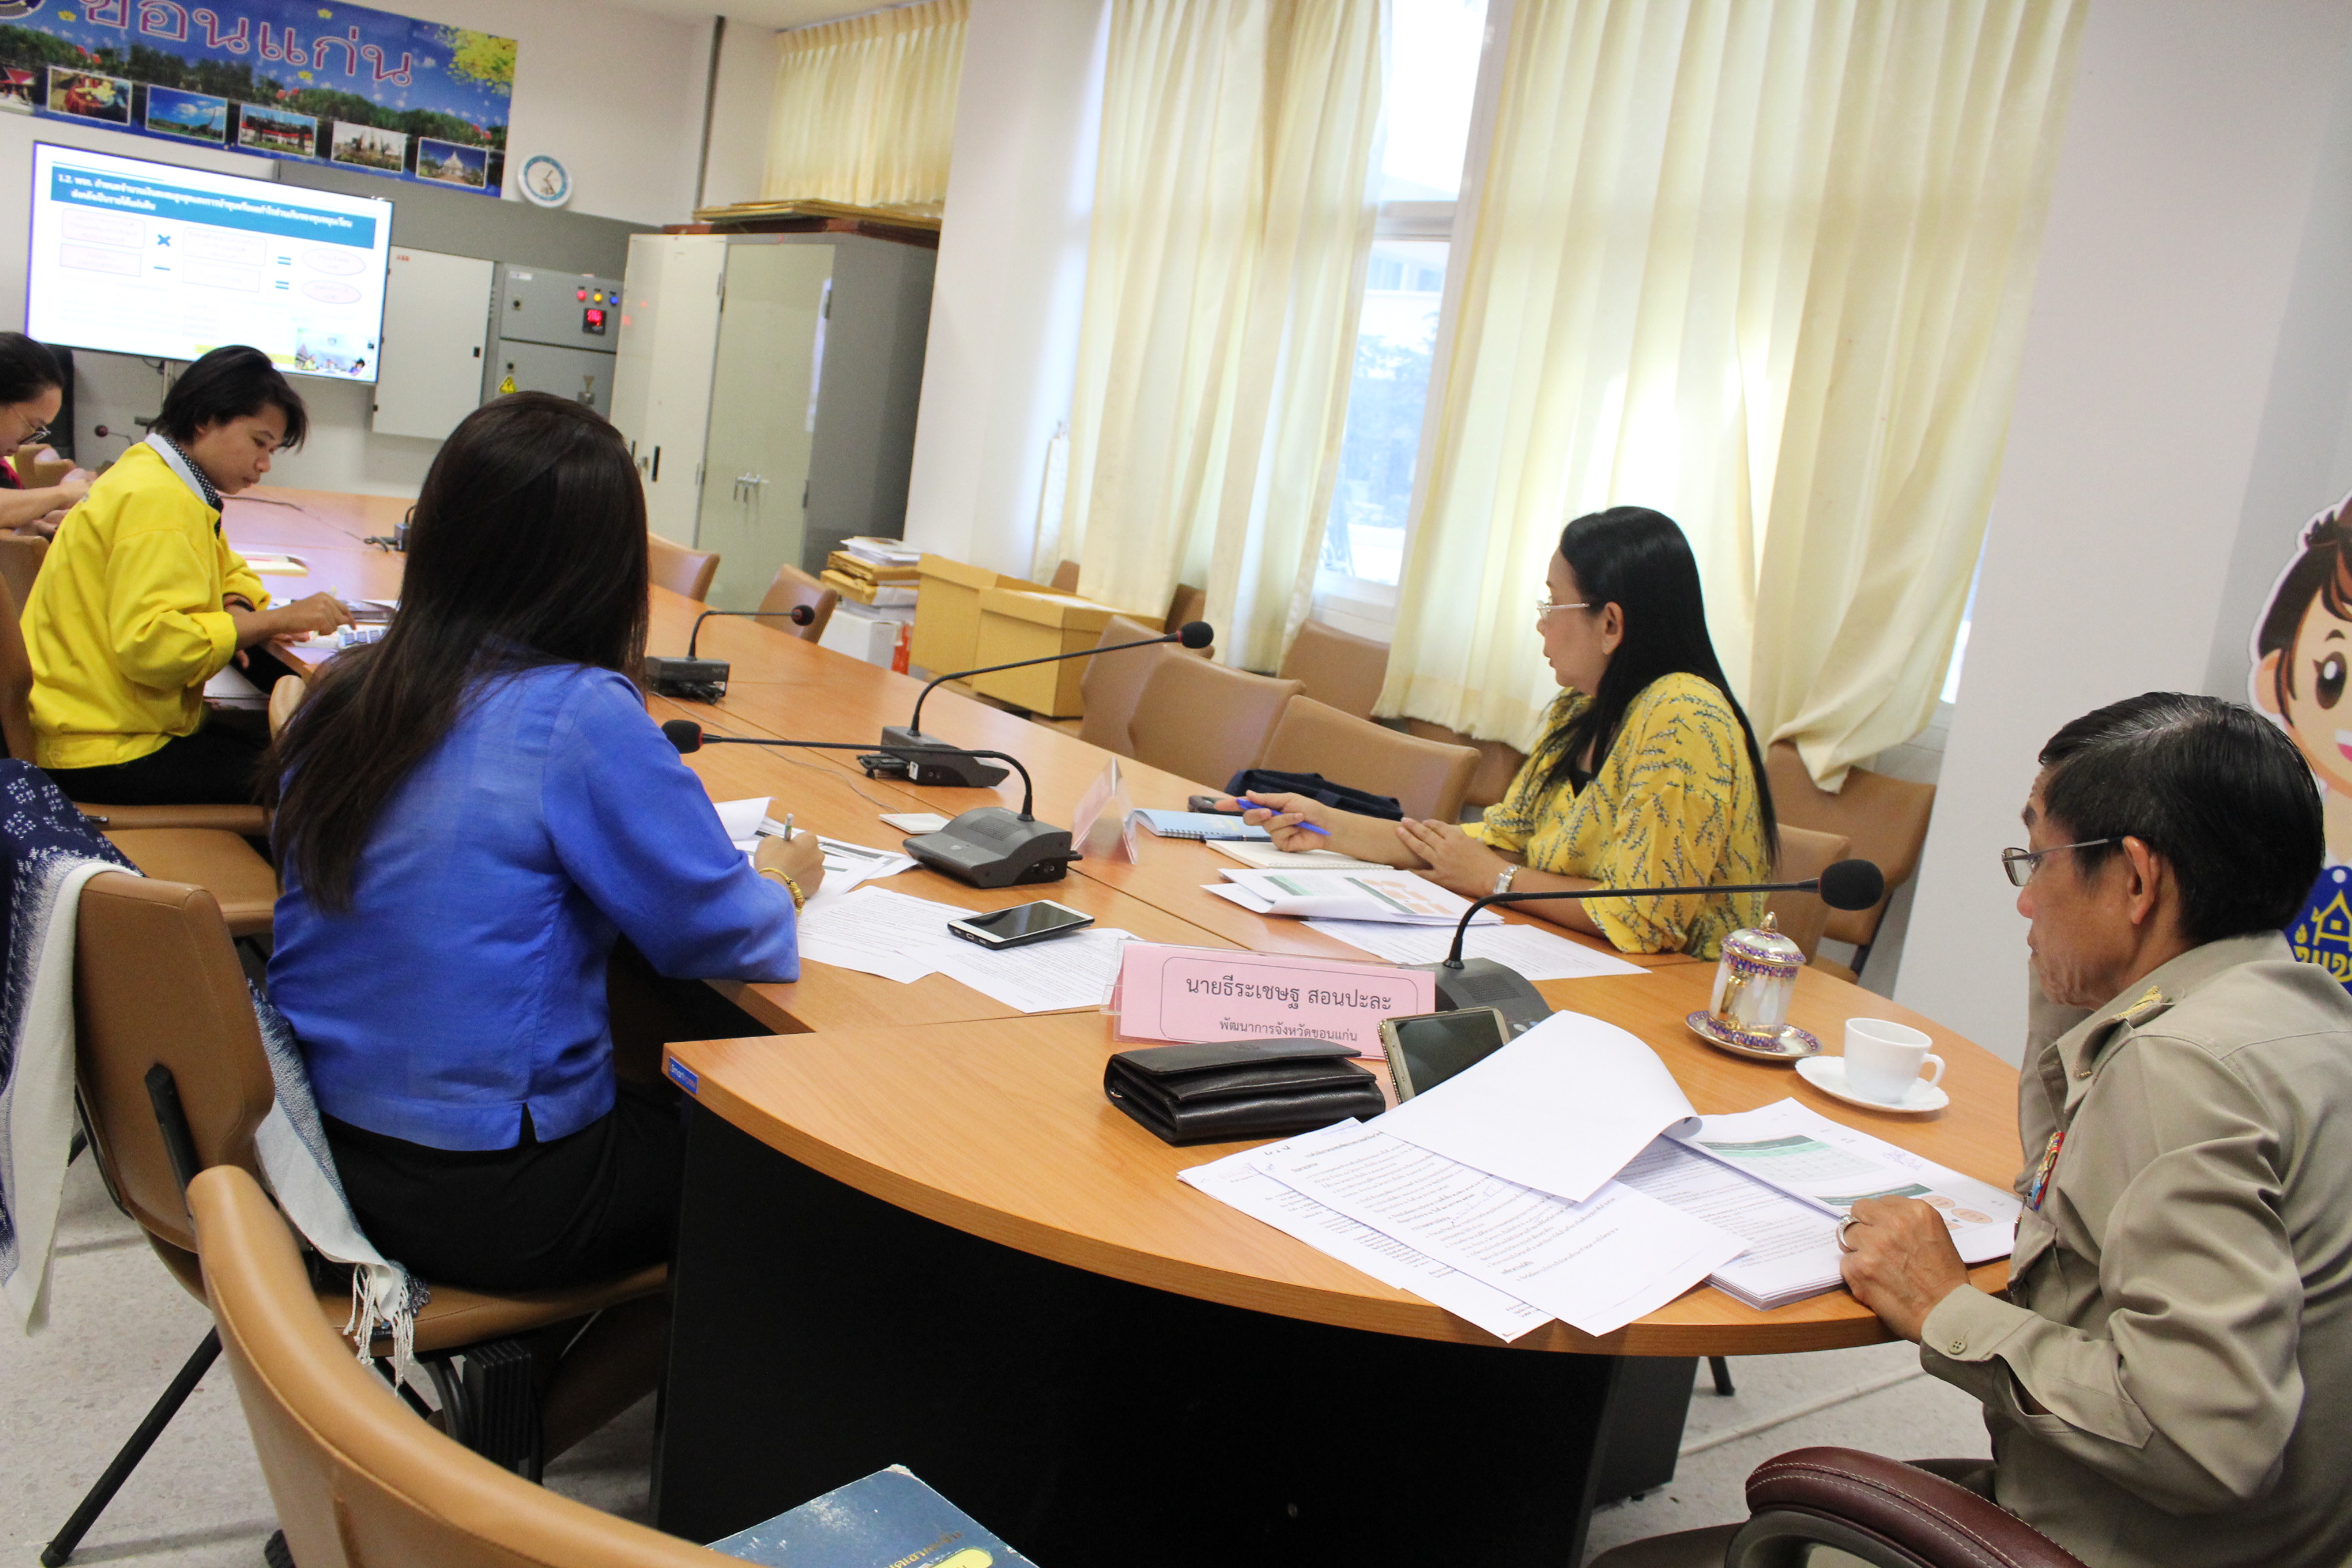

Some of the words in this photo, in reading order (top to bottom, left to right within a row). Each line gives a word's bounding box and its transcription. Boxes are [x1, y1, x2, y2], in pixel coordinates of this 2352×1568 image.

[80, 0, 412, 86] ขอนแก่น
[1186, 975, 1300, 1009] นายธีระเชษฐ
[1308, 989, 1391, 1010] สอนปะละ
[1220, 1017, 1358, 1042] พัฒนาการจังหวัดขอนแก่น
